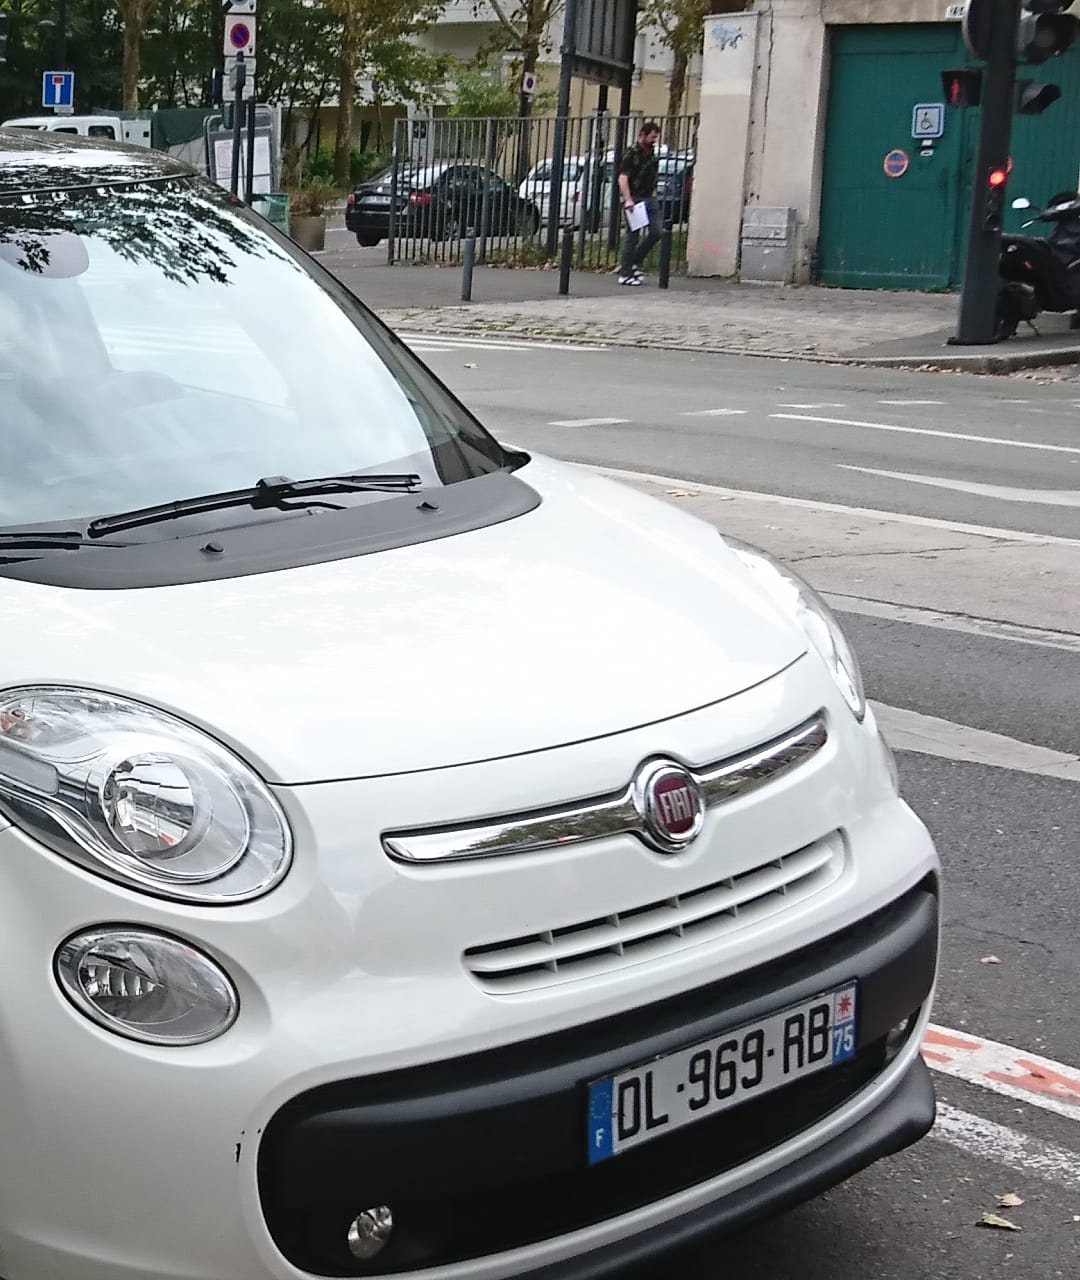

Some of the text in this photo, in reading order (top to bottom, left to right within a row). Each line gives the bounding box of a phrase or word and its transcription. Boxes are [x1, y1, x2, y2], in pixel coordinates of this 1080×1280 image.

[658, 786, 693, 824] FIAT
[834, 1026, 854, 1056] 75
[595, 1128, 604, 1148] F
